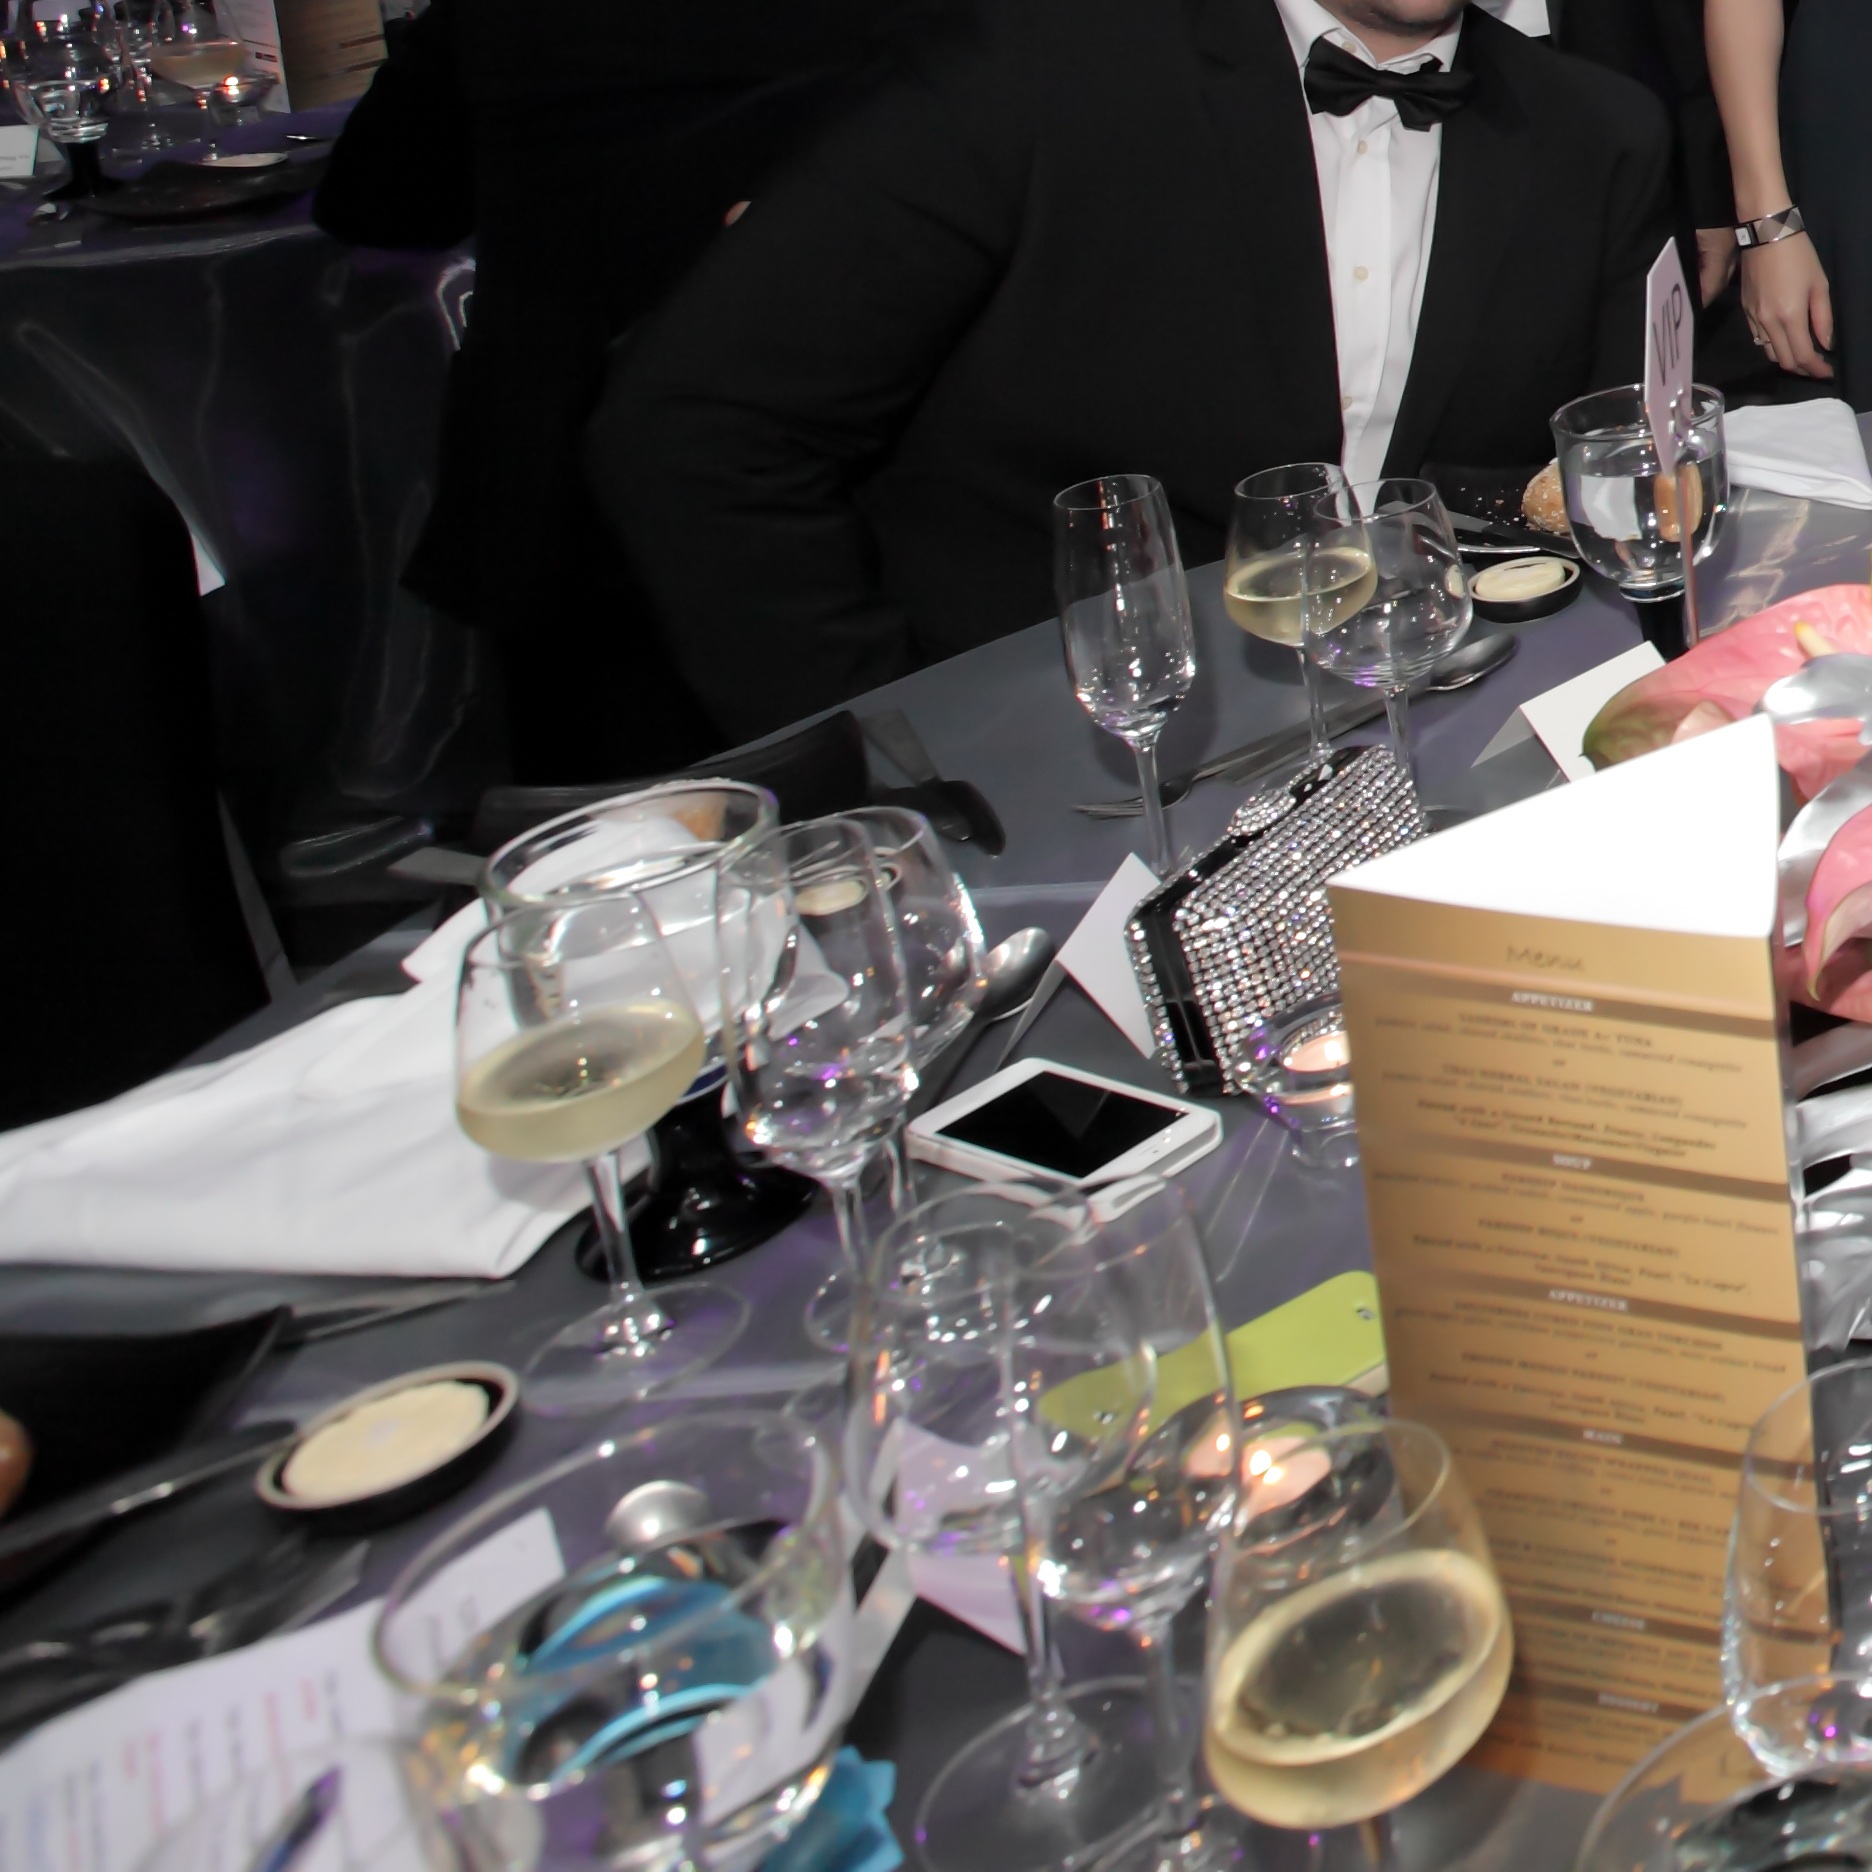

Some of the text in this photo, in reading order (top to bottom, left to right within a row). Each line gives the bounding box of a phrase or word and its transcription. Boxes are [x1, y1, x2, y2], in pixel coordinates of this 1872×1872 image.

[1652, 282, 1684, 387] VIP
[1506, 945, 1585, 971] Menu
[1510, 989, 1595, 1013] APPETIZER
[1548, 1287, 1630, 1313] APPETIZER
